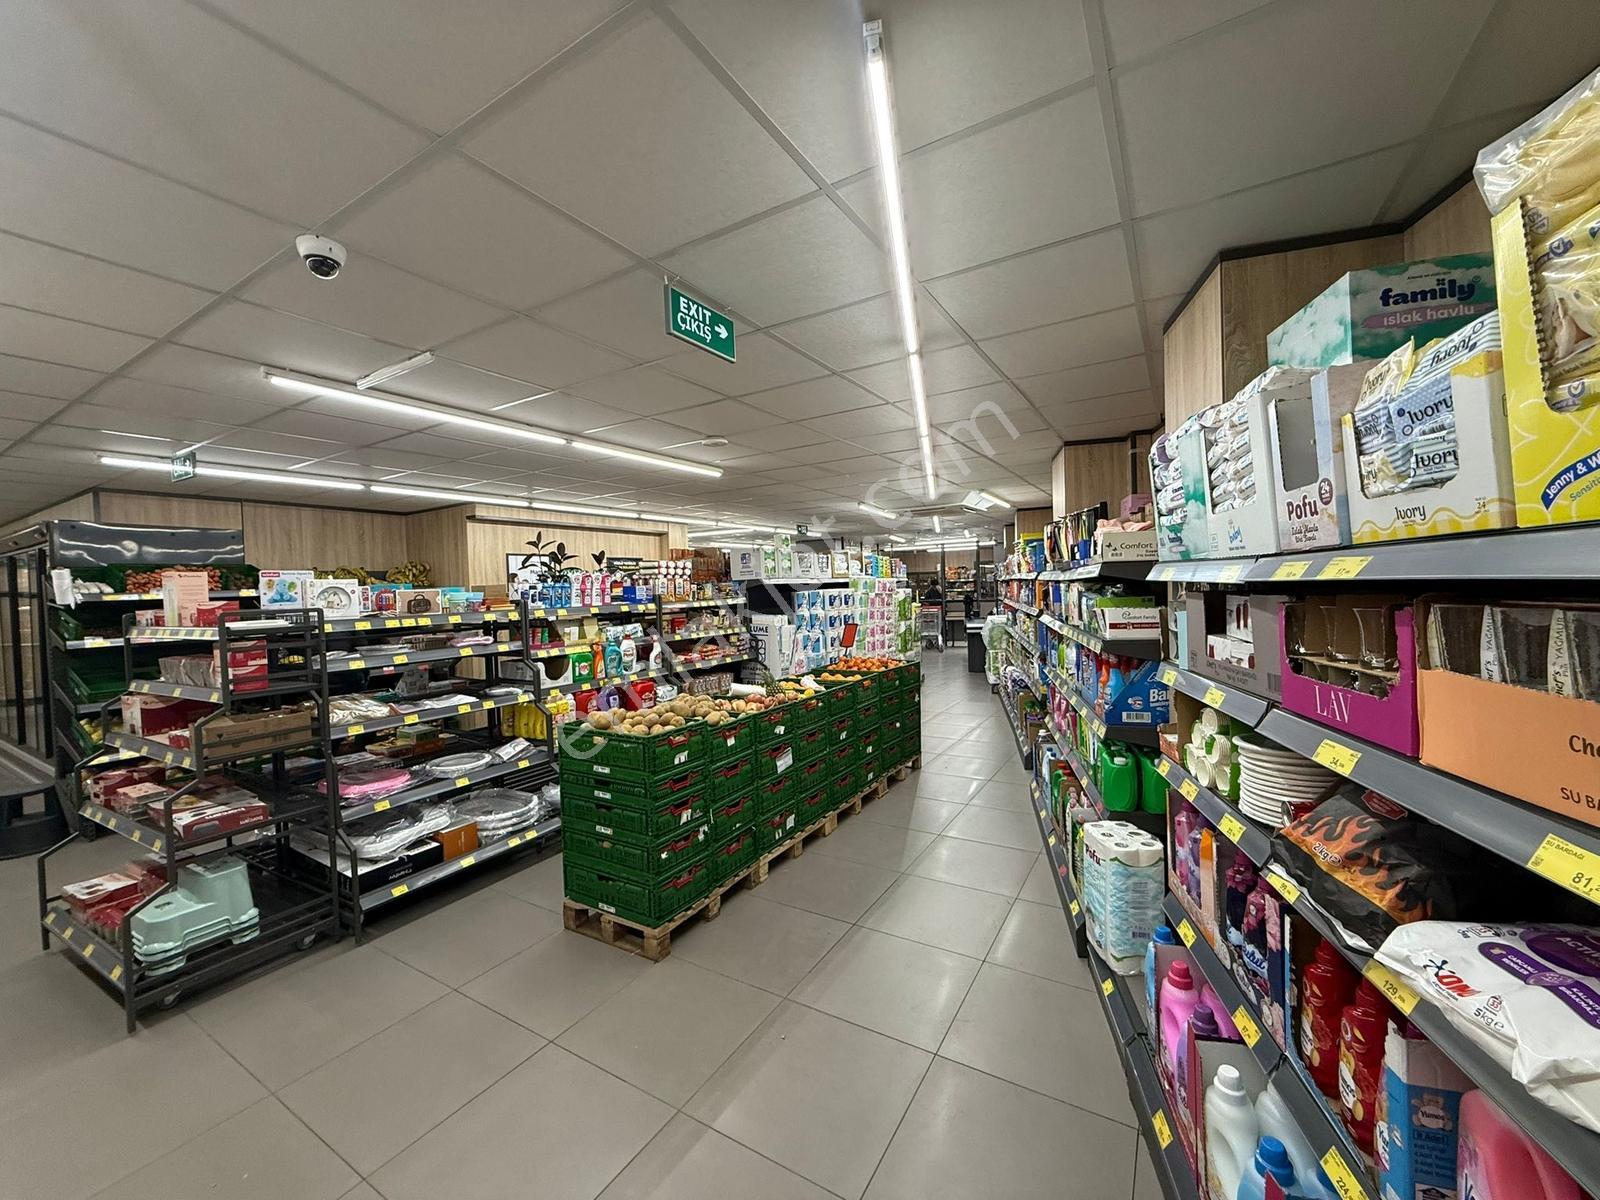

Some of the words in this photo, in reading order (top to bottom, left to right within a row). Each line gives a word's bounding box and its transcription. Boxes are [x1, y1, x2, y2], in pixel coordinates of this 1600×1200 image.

[1379, 277, 1476, 307] family
[680, 296, 711, 325] EXIT
[1427, 304, 1475, 320] havlu
[677, 312, 712, 343] ÇIKIŞ
[1546, 470, 1575, 499] Jenny
[1576, 462, 1588, 474] &
[1286, 494, 1319, 521] Pofu
[1395, 505, 1426, 521] Ivory
[1120, 542, 1153, 550] Comfort
[1314, 685, 1352, 725] LAV
[1560, 786, 1581, 804] SU
